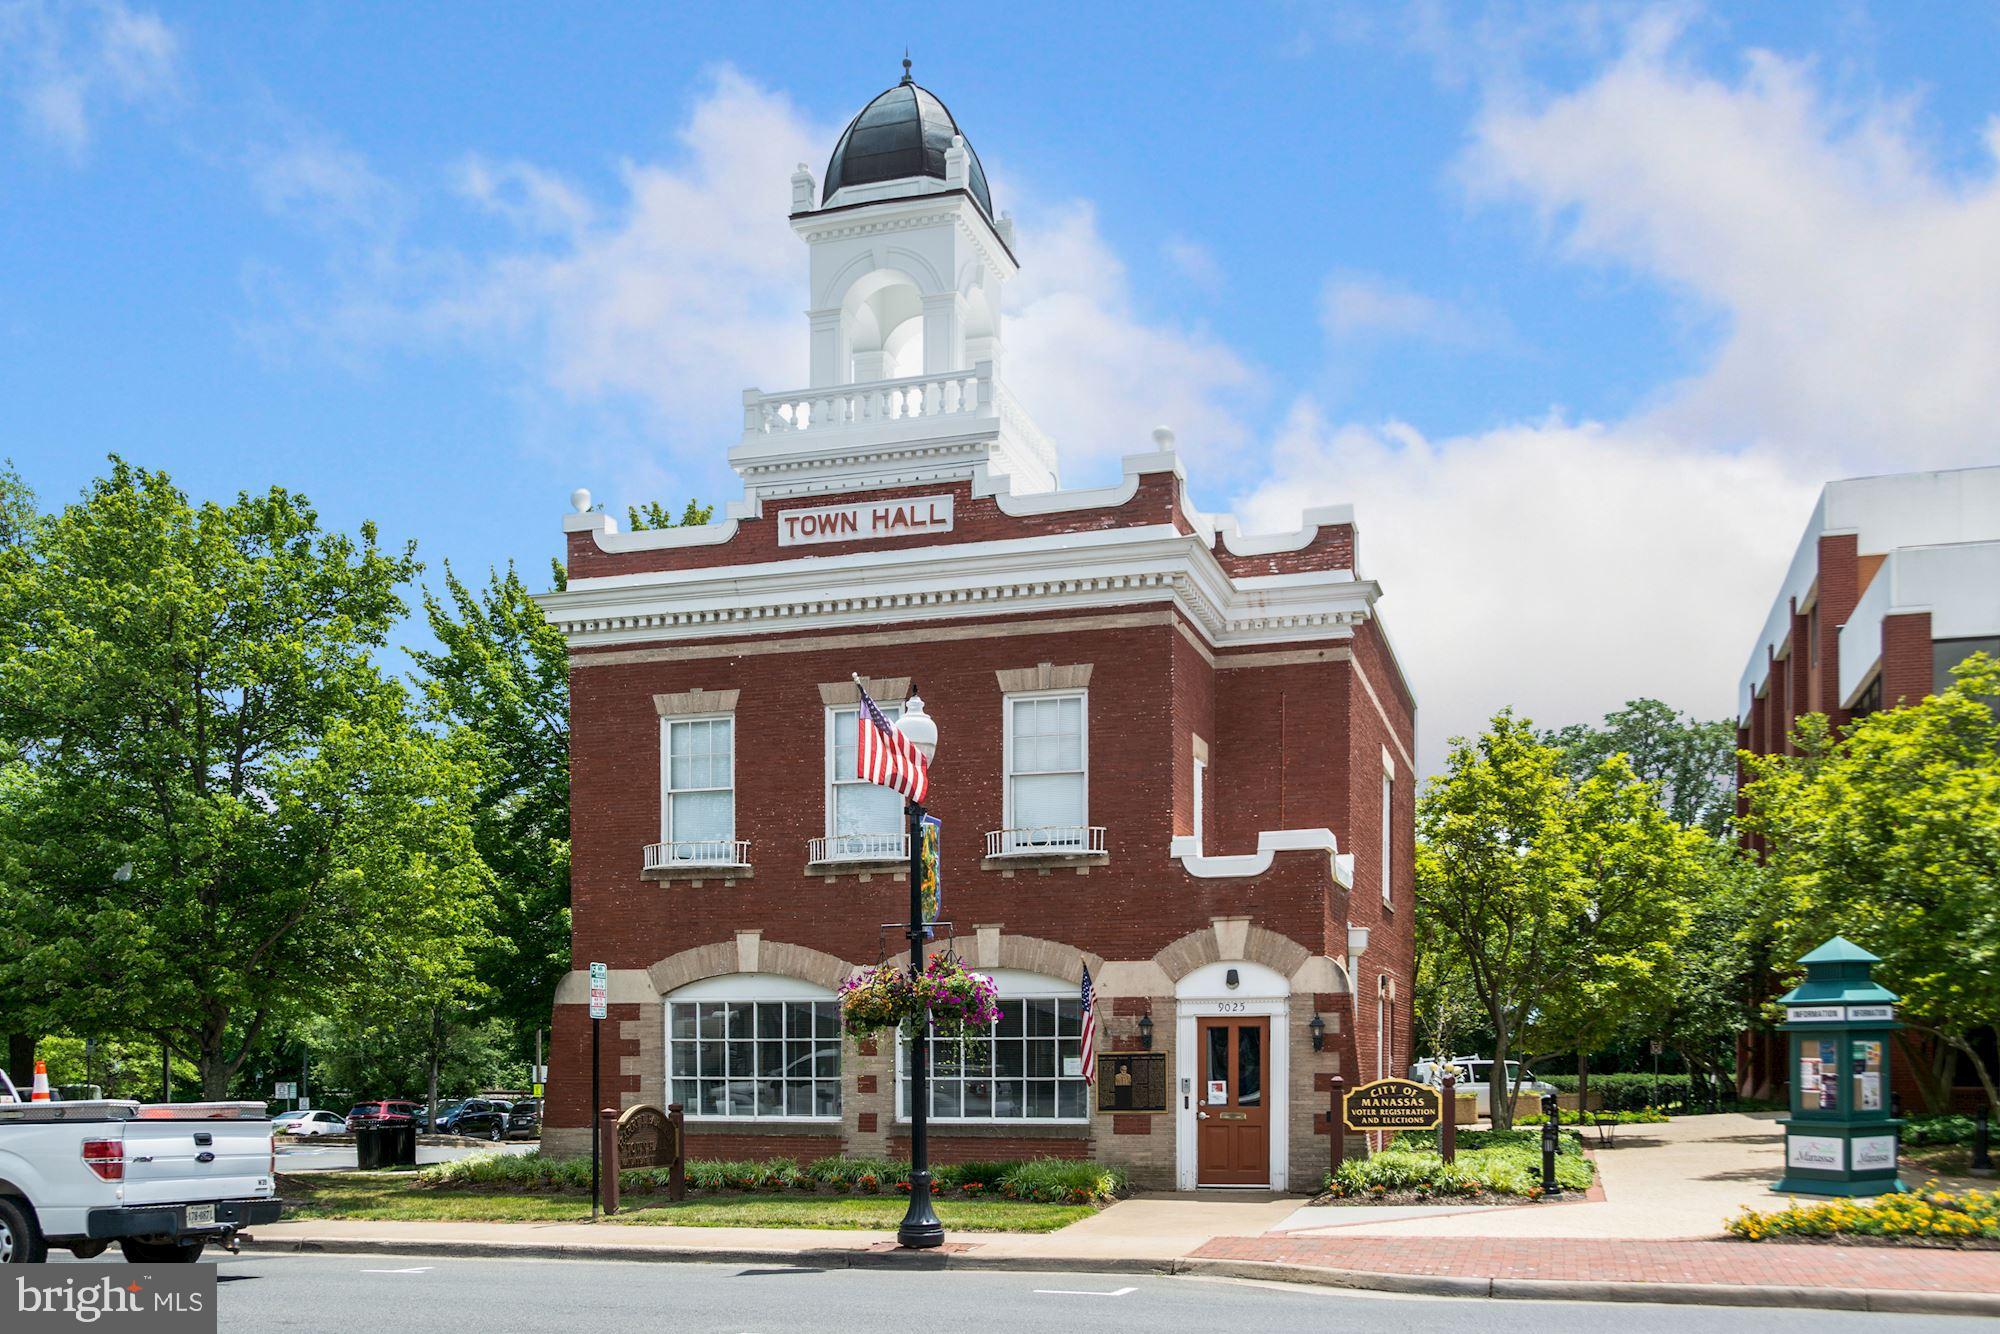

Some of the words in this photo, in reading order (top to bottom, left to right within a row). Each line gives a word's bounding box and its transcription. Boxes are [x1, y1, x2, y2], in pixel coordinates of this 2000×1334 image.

[784, 511, 858, 538] TOWN
[872, 504, 947, 530] HALL
[1218, 1003, 1245, 1012] 9025
[1793, 1010, 1837, 1018] INFORMATION
[1370, 1085, 1397, 1097] CITY
[1403, 1087, 1418, 1097] OF
[1361, 1098, 1425, 1107] MANASSAS
